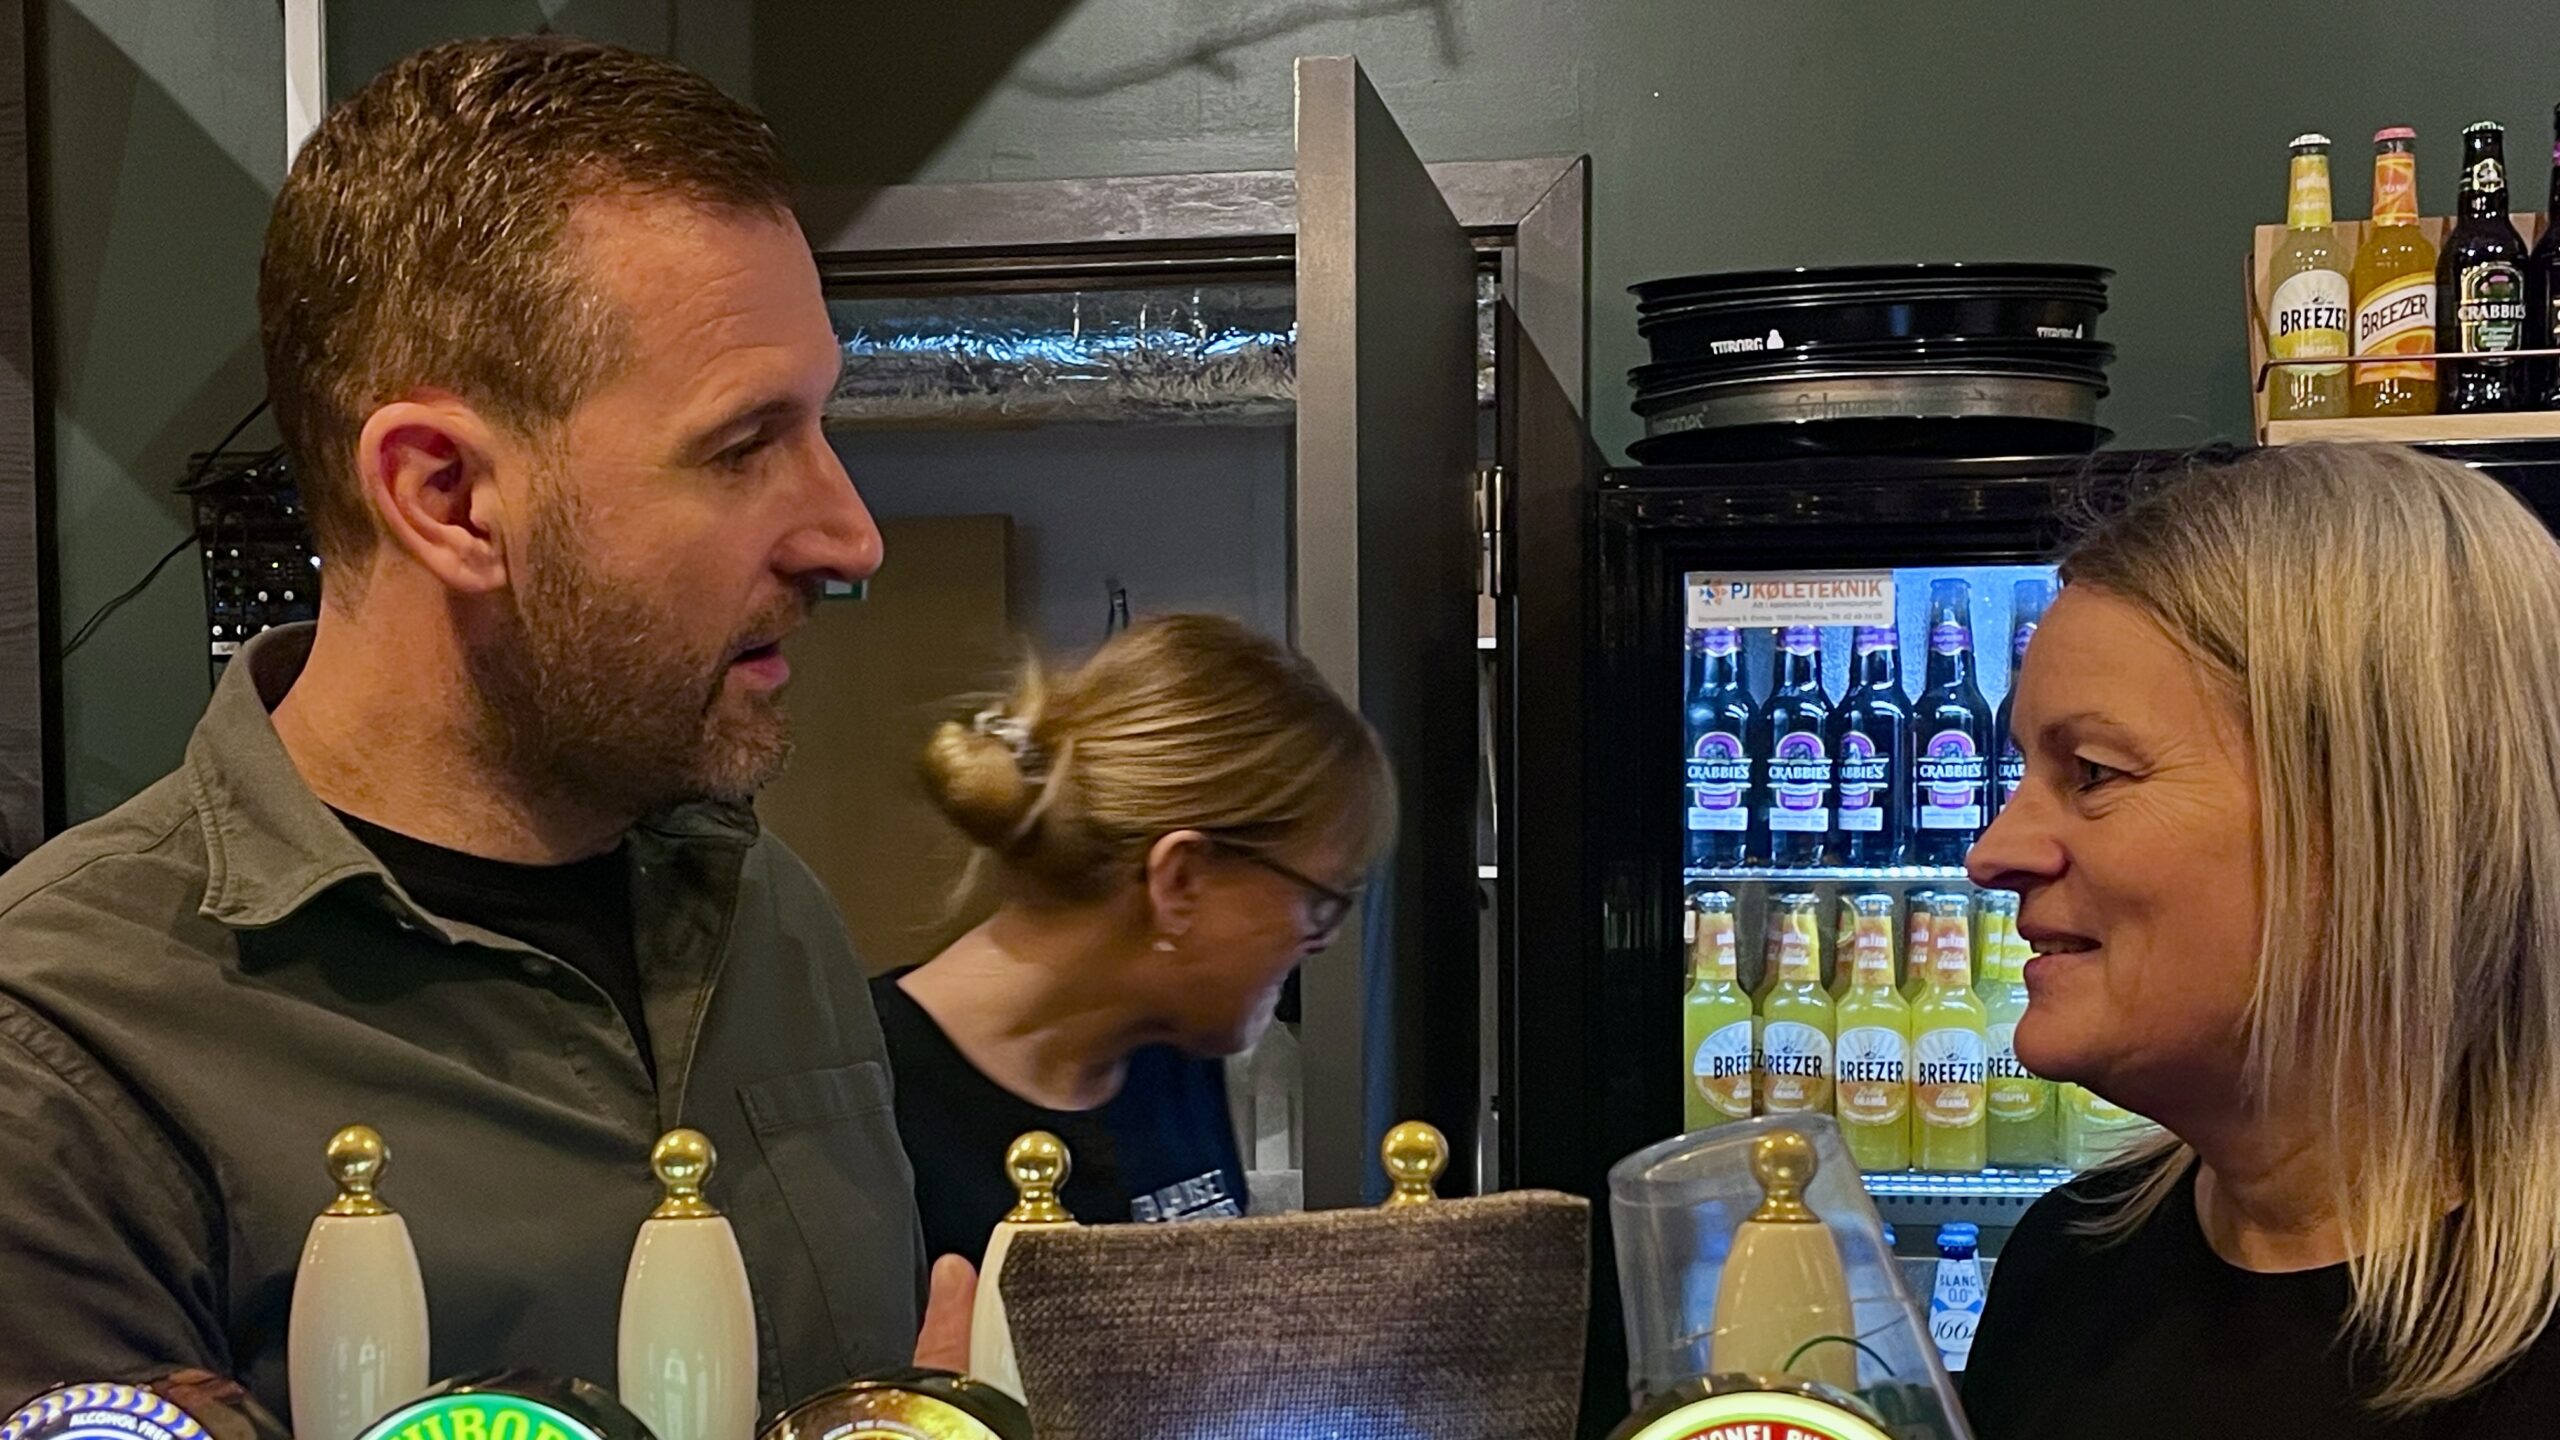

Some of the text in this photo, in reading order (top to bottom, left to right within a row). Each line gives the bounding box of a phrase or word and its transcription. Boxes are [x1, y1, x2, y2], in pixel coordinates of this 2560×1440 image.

[2362, 293, 2429, 341] BREEZER
[1840, 764, 1886, 779] ABBIE'S
[1713, 1055, 1751, 1080] BREE
[1840, 1060, 1905, 1086] BREEZER
[1919, 1061, 1984, 1088] BREEZER
[1988, 1057, 2035, 1079] REEZ
[1940, 1274, 1977, 1287] BLANC
[69, 1410, 138, 1431] ALCOHOL
